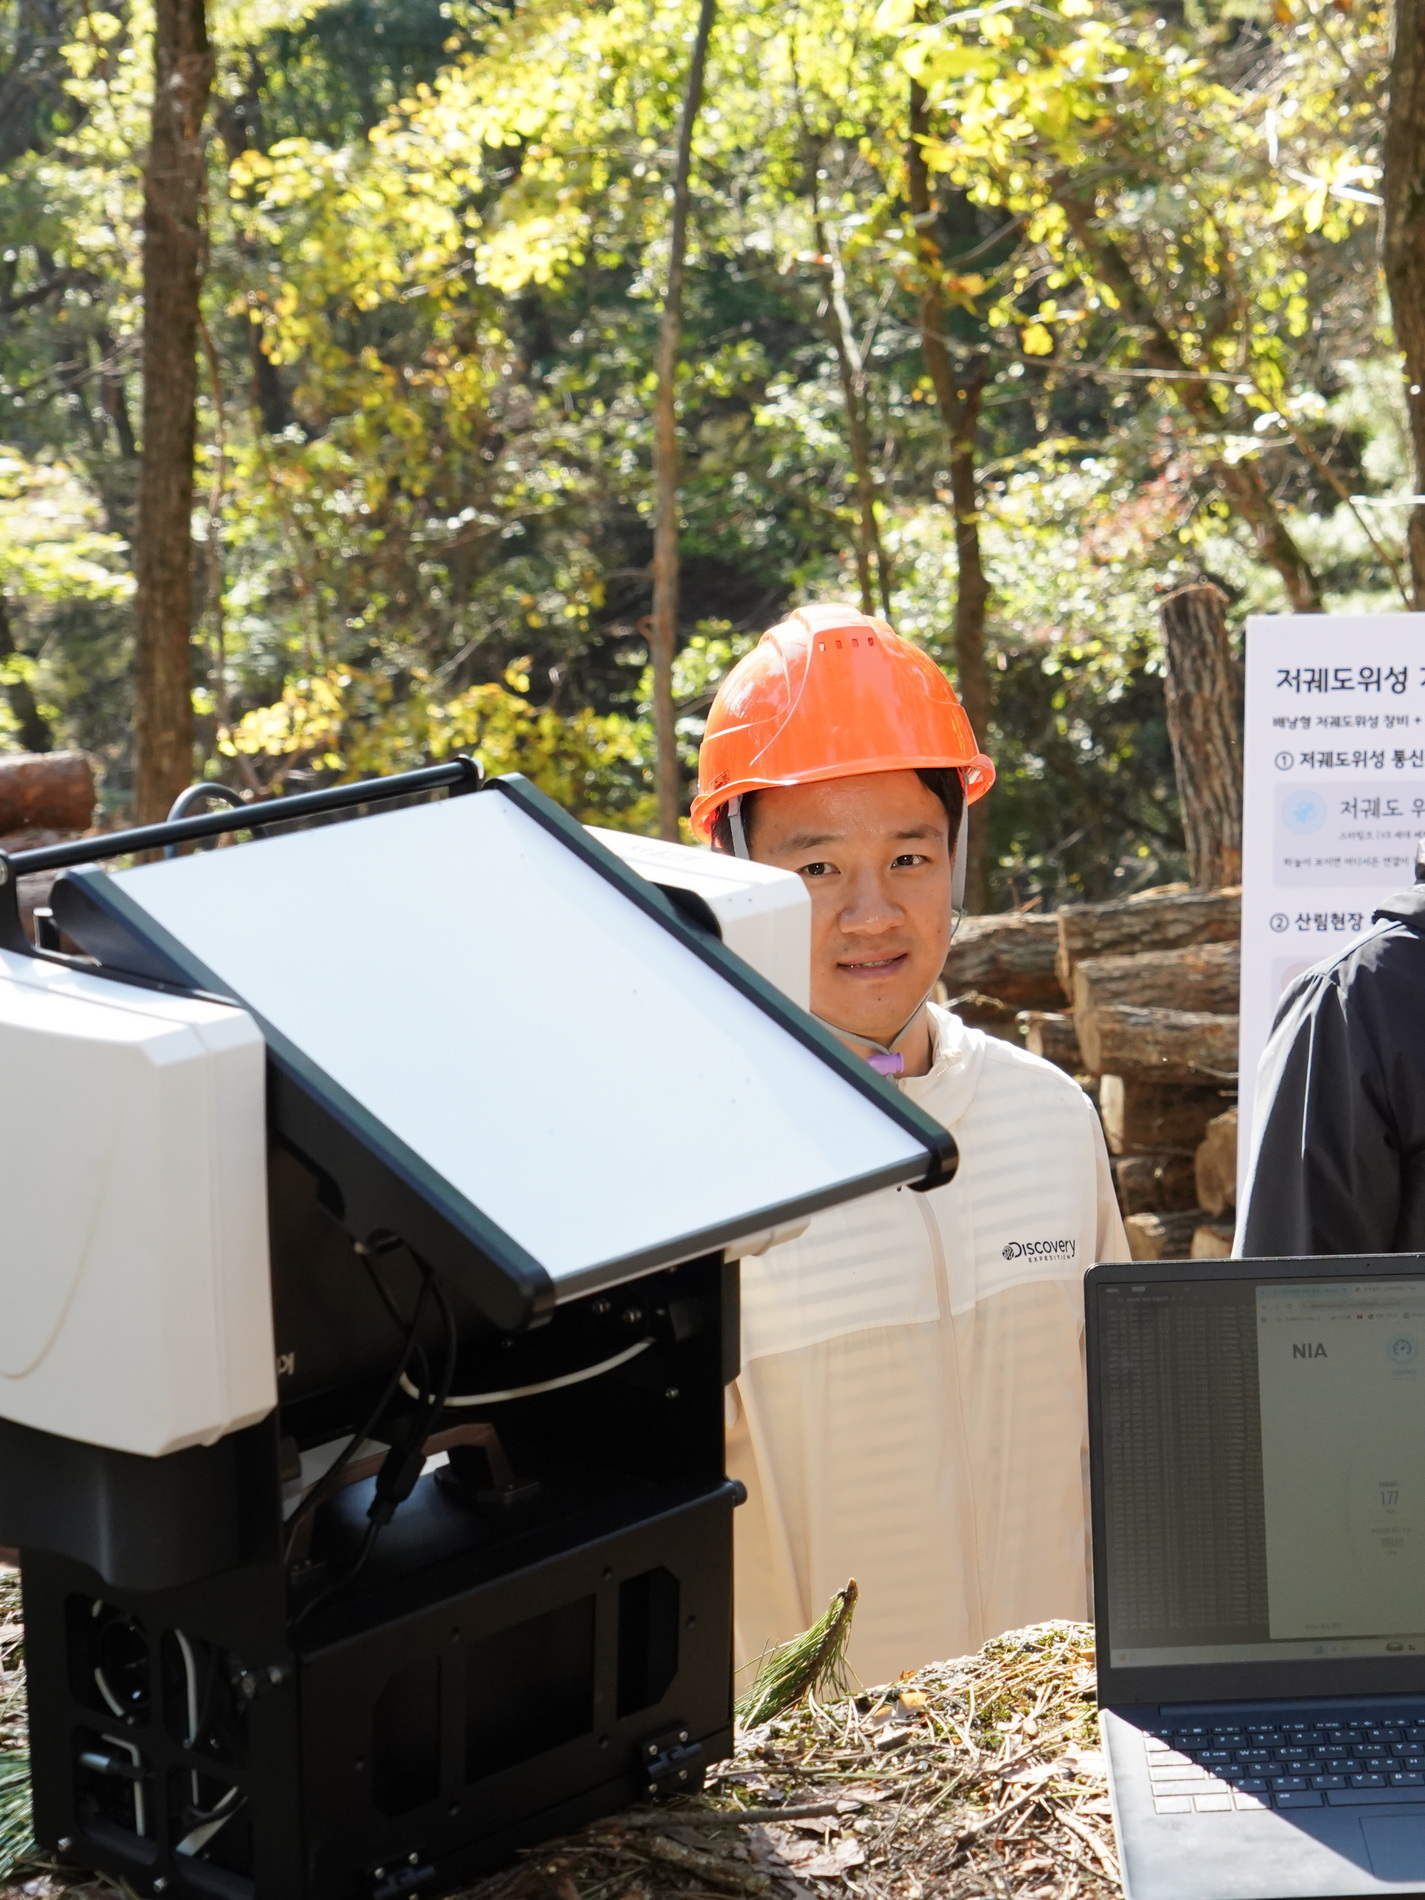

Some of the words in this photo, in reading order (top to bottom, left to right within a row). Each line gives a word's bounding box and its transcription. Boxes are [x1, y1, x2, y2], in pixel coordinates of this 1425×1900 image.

[1275, 666, 1408, 694] 저궤도위성
[1272, 715, 1312, 731] 배낭형
[1316, 714, 1379, 729] 저궤도위성
[1384, 714, 1409, 729] 장비
[1299, 750, 1386, 770] 저궤도위성
[1339, 796, 1404, 820] 저궤도
[1294, 912, 1364, 932] 산림현장
[1028, 1254, 1071, 1263] EXPEDITION
[1292, 1342, 1329, 1360] NIA
[1380, 1489, 1400, 1506] 1.77
